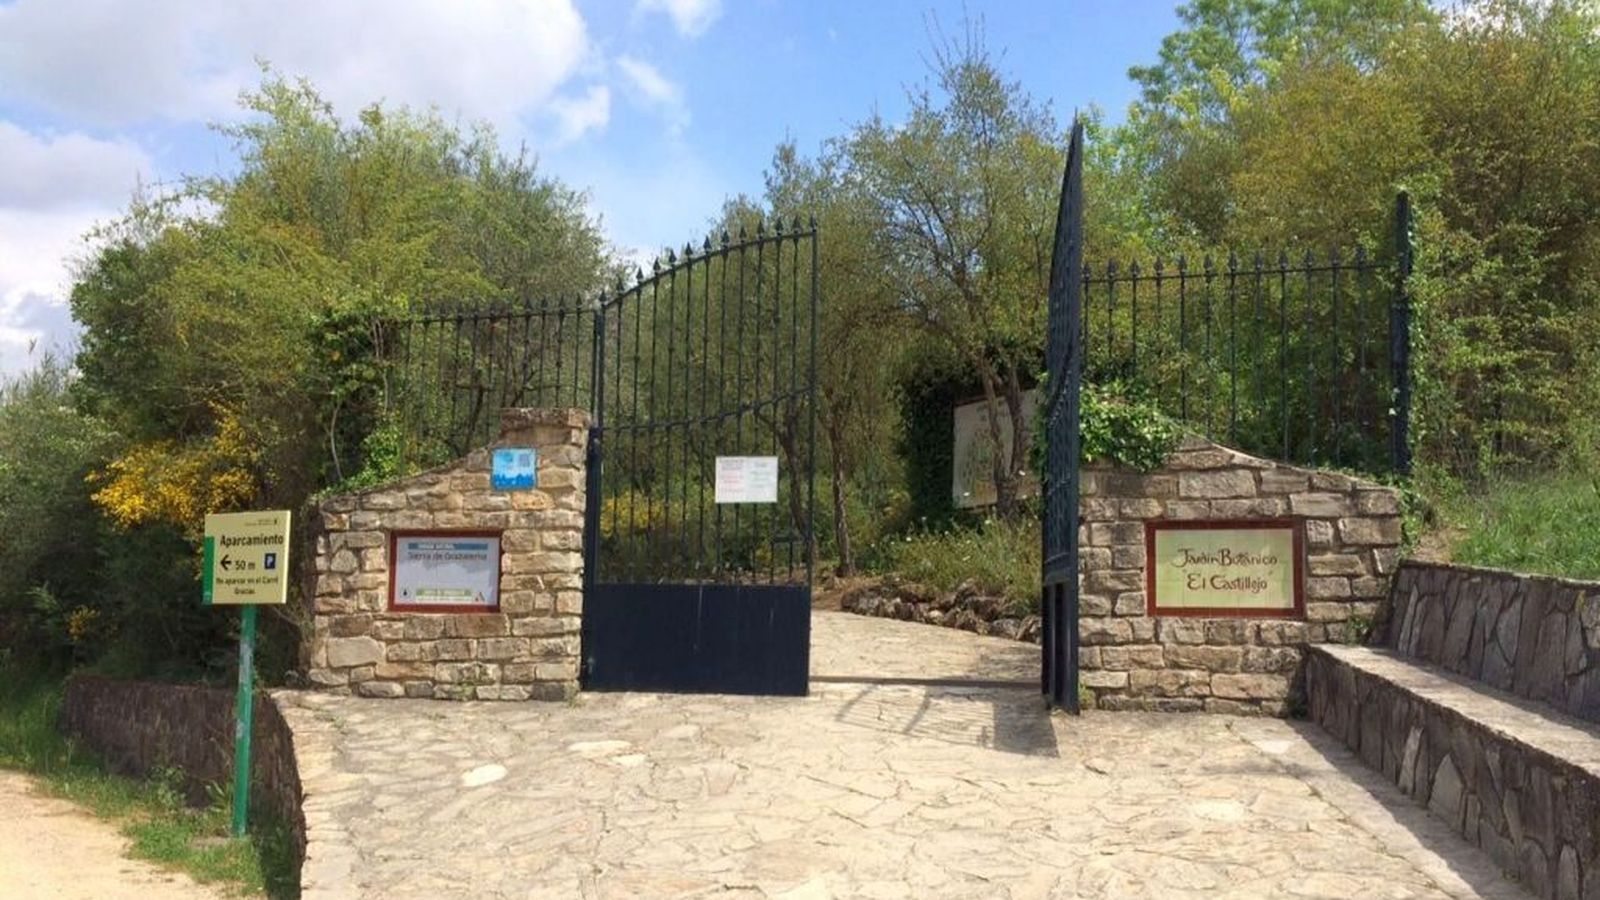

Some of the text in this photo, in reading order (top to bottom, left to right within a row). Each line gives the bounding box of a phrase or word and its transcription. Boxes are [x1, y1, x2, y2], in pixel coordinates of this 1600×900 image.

[221, 534, 284, 548] Aparcamiento
[432, 552, 443, 560] de
[235, 561, 255, 570] 50 m
